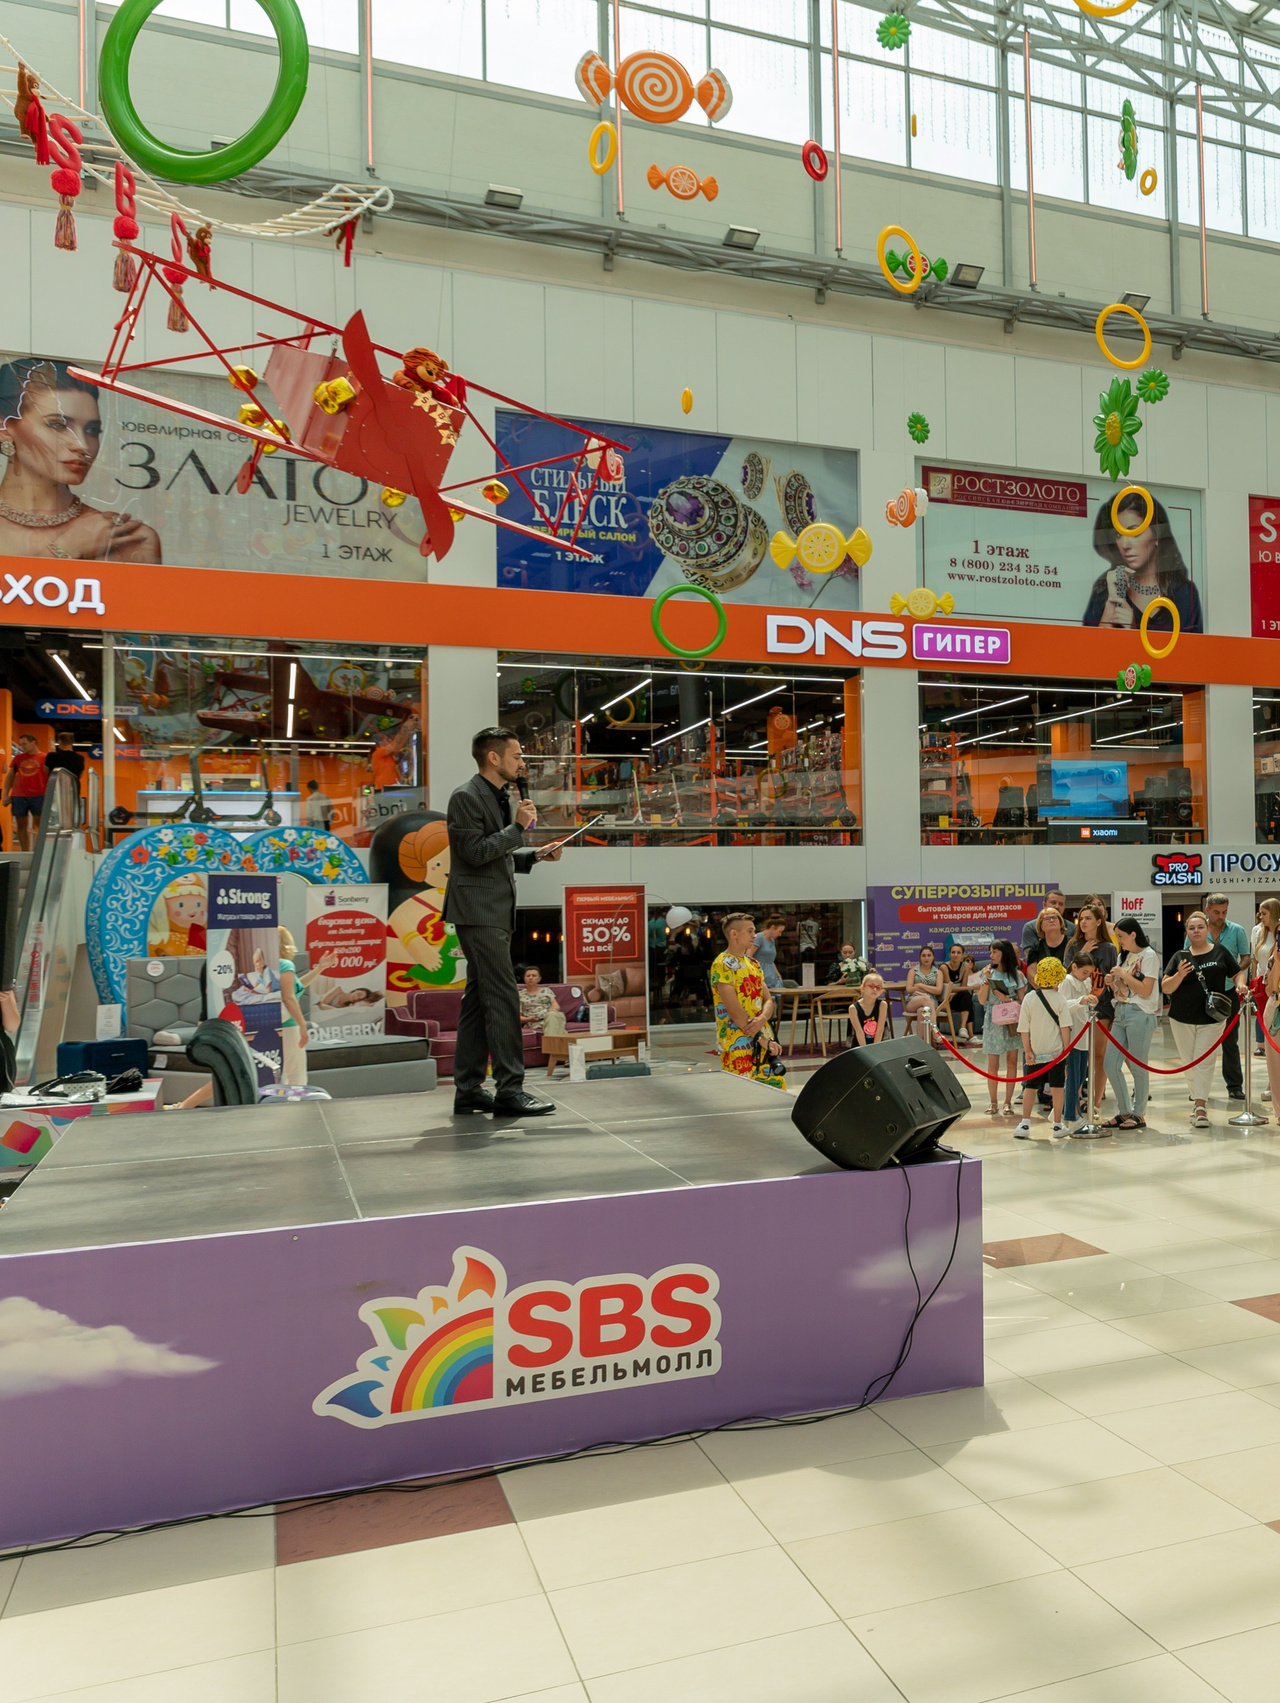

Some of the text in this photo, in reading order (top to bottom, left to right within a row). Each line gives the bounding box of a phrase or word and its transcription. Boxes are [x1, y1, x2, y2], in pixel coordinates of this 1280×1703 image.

[121, 420, 222, 441] ювелирная
[953, 474, 1081, 503] РОСТЗОЛОТО
[283, 503, 398, 530] JEWELRY
[531, 489, 630, 529] БЛЕСК
[598, 530, 637, 543] САЛОН
[322, 544, 394, 563] 1 ЭТАЖ
[972, 539, 1030, 559] 1 этаж
[555, 551, 605, 564] 1 ЭТАЖ
[949, 558, 1059, 576] 8 (800) 234 35 54
[947, 571, 1062, 589] www.rostzoloto.com
[0, 573, 106, 616] ХОД
[1261, 619, 1266, 631] 1
[766, 614, 908, 660] DNS
[922, 632, 1001, 655] ГИПЕР
[56, 703, 100, 715] DNS
[1092, 829, 1118, 837] xiaomi
[1168, 862, 1189, 873] PRO
[1154, 871, 1202, 885] SUSHI
[1209, 877, 1240, 885] SUSHI
[229, 888, 271, 909] Strong
[891, 884, 1046, 899] СУПЕРРОЗЫГРЫШ
[338, 895, 369, 904] Sonberry
[1121, 897, 1144, 910] Hoff
[917, 903, 1022, 913] бытовой техники, матрасов
[939, 912, 971, 920] товаров
[582, 926, 632, 943] 50%
[928, 925, 1012, 934] каждое воскресенье
[596, 943, 614, 952] всё
[735, 1060, 753, 1070] BAN
[507, 1273, 712, 1369] SBS
[506, 1348, 713, 1398] МЕБЕЛЬМОЛЛ
